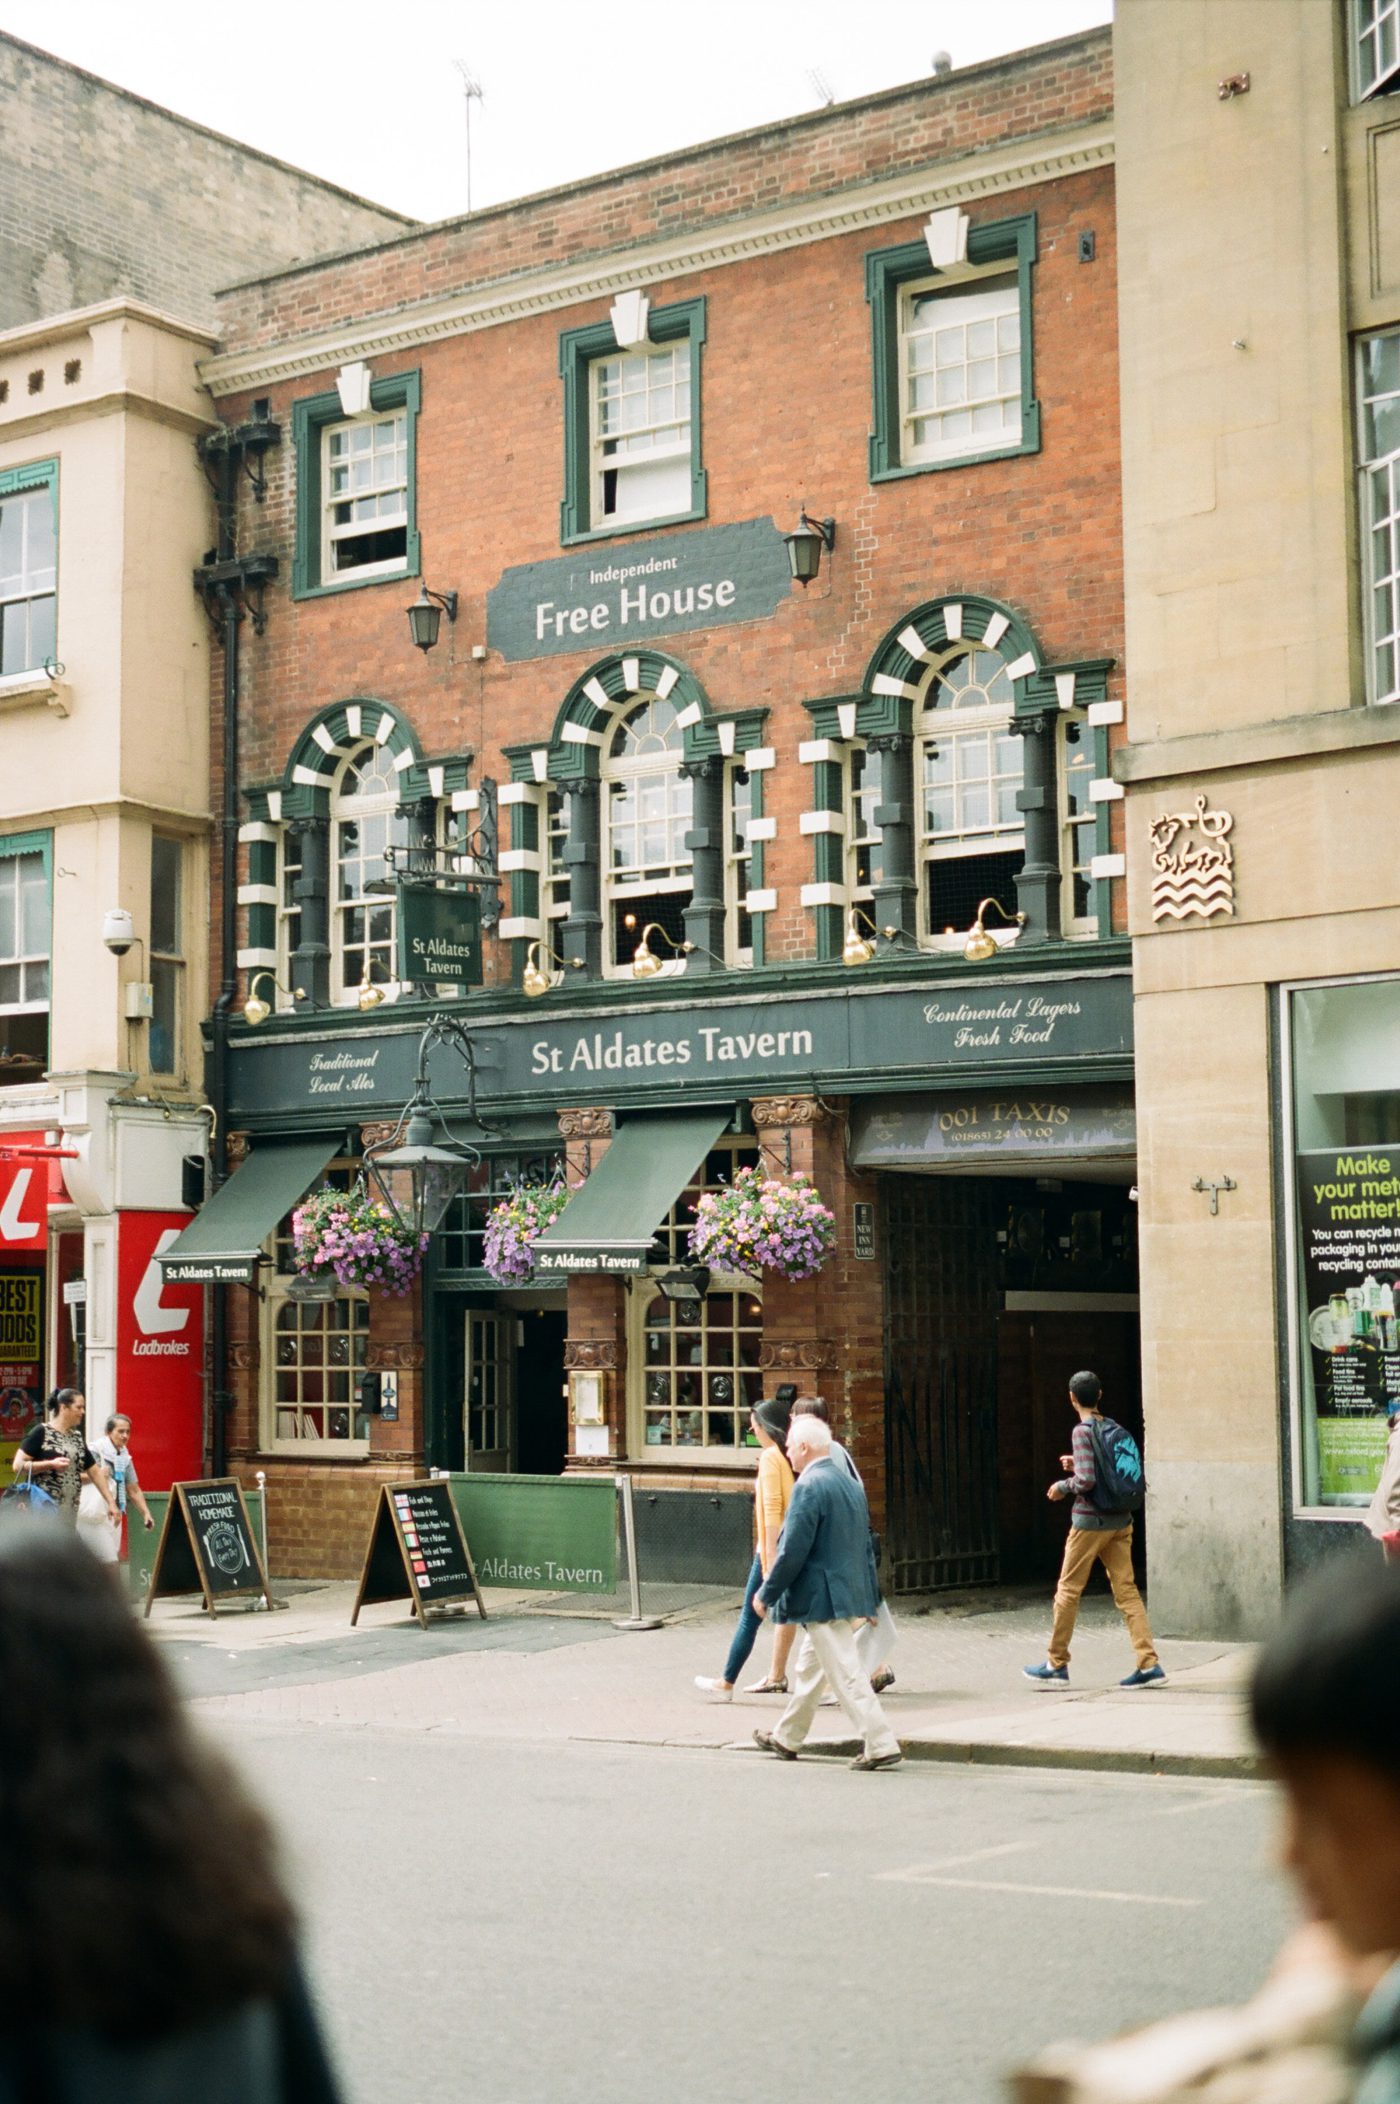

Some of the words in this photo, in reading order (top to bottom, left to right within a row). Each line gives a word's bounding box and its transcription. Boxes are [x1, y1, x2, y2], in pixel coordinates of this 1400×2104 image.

[590, 556, 679, 585] Independent
[536, 601, 610, 640] Free
[620, 578, 736, 625] House
[412, 937, 425, 955] St
[427, 937, 470, 957] Aldates
[424, 957, 462, 975] Tavern
[923, 998, 1022, 1024] Continental
[1025, 997, 1082, 1024] Lagers
[954, 1025, 1000, 1048] Fresh
[1009, 1022, 1055, 1045] Food
[309, 1049, 379, 1071] Traditional
[531, 1041, 564, 1075] St
[569, 1031, 691, 1072] Aldates
[697, 1026, 813, 1062] Tavern
[308, 1074, 345, 1094] Local
[346, 1072, 375, 1091] Ales
[939, 1105, 979, 1132] 001
[988, 1101, 1071, 1126] TAXIS
[994, 1129, 1011, 1140] 24
[1035, 1127, 1053, 1138] 00
[1336, 1153, 1391, 1176] Make
[1313, 1181, 1357, 1204] your
[1361, 1176, 1400, 1197] met
[857, 1225, 872, 1233] NEW
[1312, 1228, 1332, 1240] You
[1334, 1229, 1353, 1239] can
[1355, 1224, 1392, 1240] recycle
[856, 1247, 874, 1256] YARD
[1310, 1242, 1365, 1258] packaging
[1367, 1241, 1377, 1254] in
[539, 1254, 553, 1268] St
[554, 1253, 598, 1268] Aldates
[599, 1254, 640, 1268] Tavern
[1318, 1257, 1364, 1273] recycling
[166, 1267, 177, 1279] St
[178, 1265, 214, 1279] Aldates
[213, 1265, 248, 1278] Tavern
[132, 1339, 190, 1356] Ladbrokes
[188, 1491, 238, 1507] TRADITIONAL
[198, 1505, 236, 1520] HOMEMADE
[482, 1557, 541, 1580] Aldates
[545, 1561, 603, 1583] Tavern
